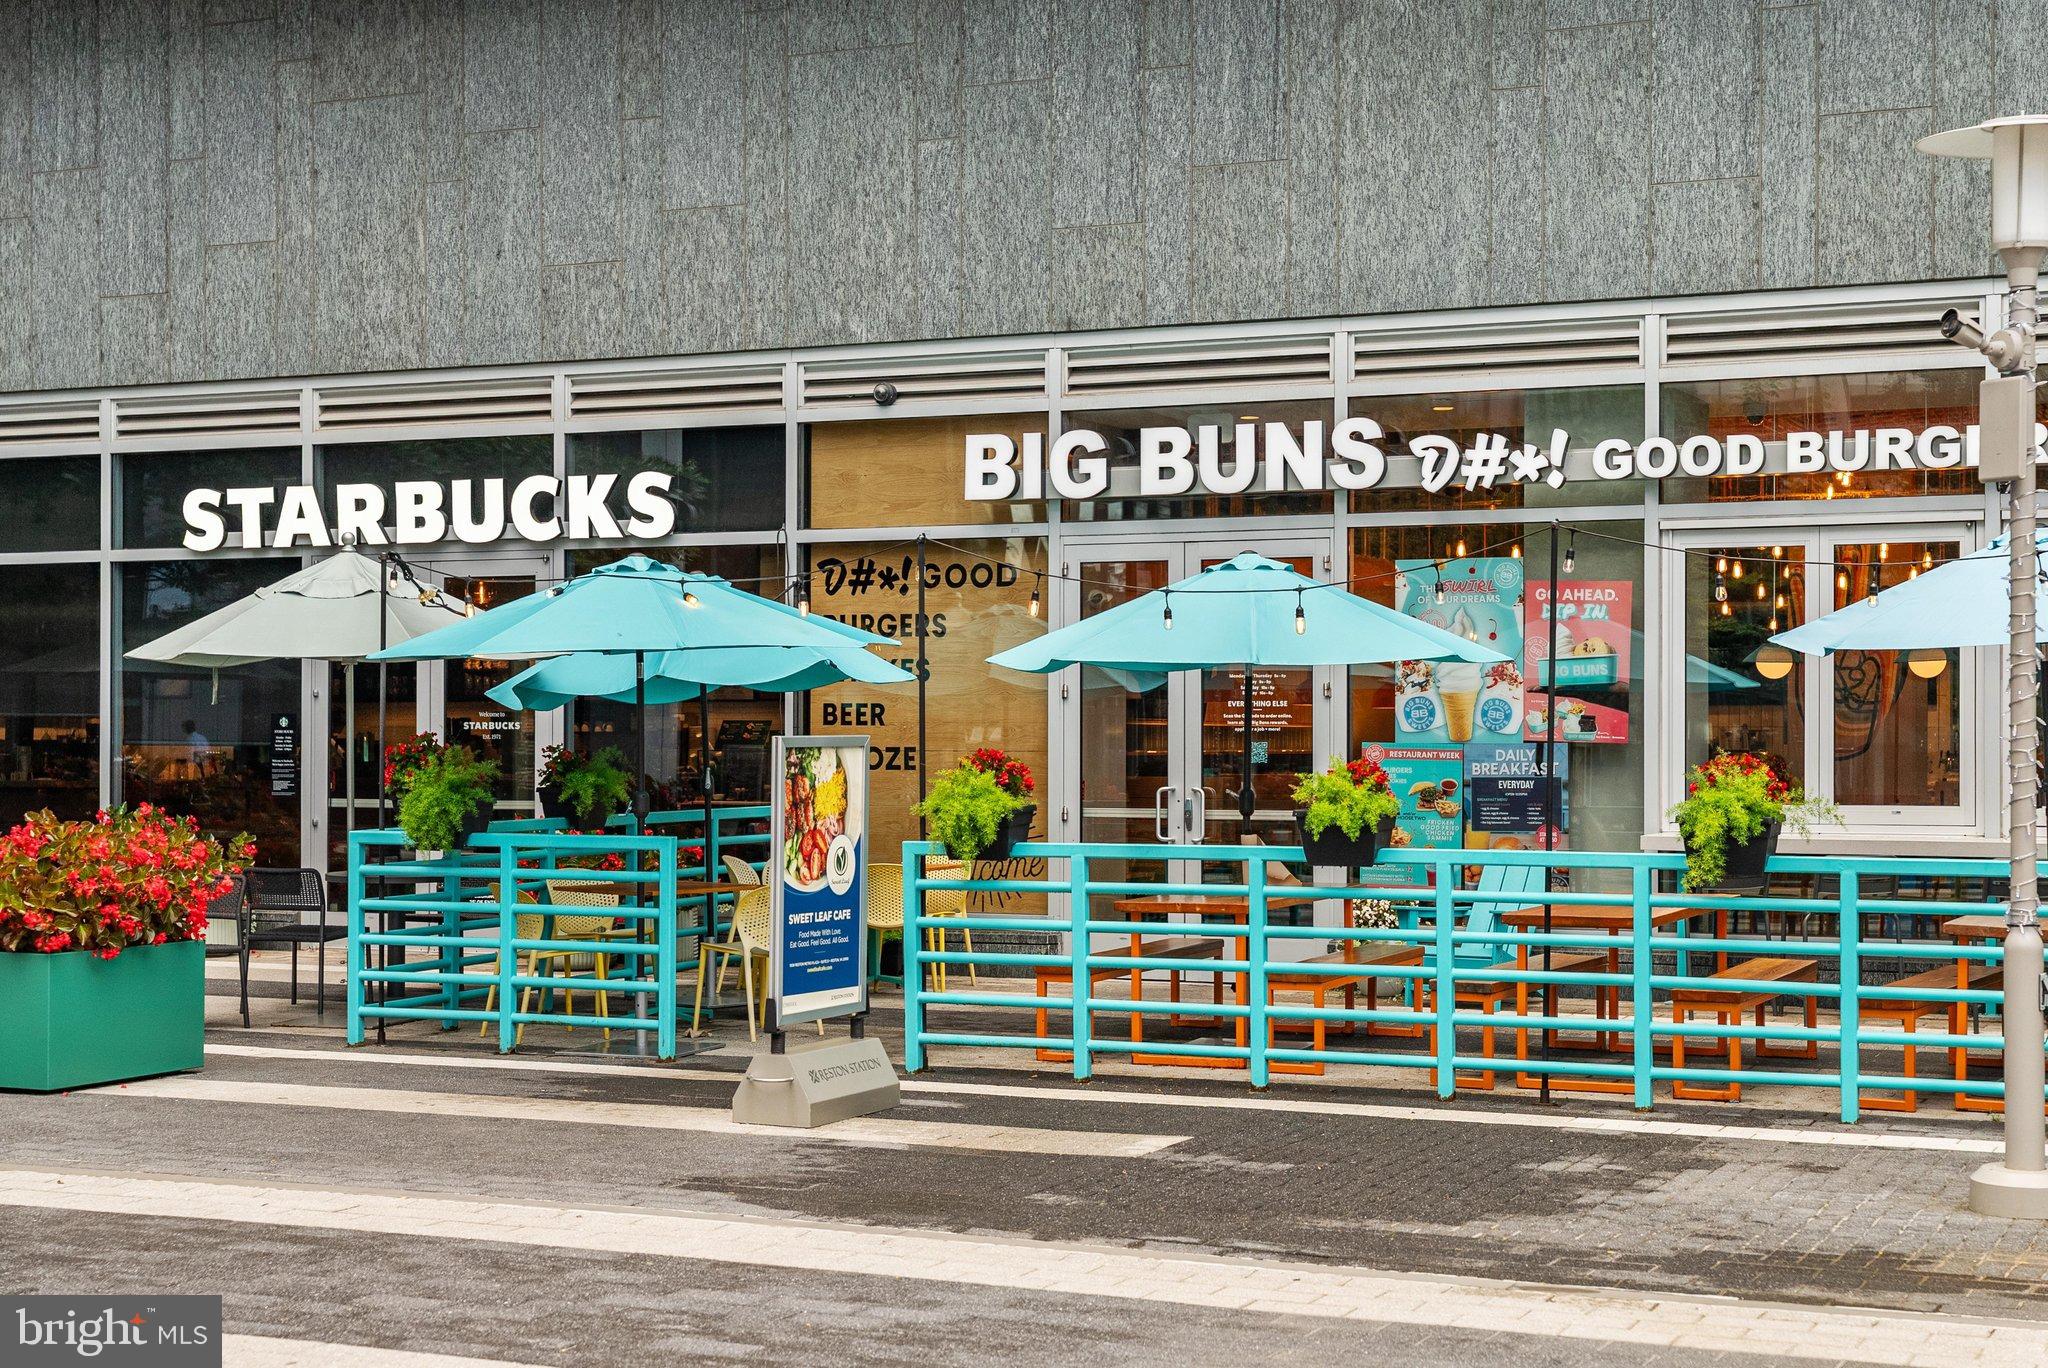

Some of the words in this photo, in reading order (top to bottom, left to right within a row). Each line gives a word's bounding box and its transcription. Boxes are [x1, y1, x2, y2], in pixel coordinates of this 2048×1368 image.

[965, 430, 1110, 500] BIG
[1140, 417, 1386, 495] BUNS
[1592, 434, 1766, 480] GOOD
[182, 471, 678, 551] STARBUCKS
[924, 562, 1018, 588] GOOD
[1420, 584, 1436, 593] TH
[1441, 579, 1498, 593] SWIRL
[1417, 596, 1431, 604] OF
[1461, 594, 1501, 604] DREAMS
[1562, 588, 1619, 601] AHEAD.
[1581, 603, 1609, 620] IN.
[1572, 663, 1609, 676] BUNS
[822, 702, 886, 727] BEER
[463, 721, 521, 730] STARBUCKS
[869, 746, 917, 771] OZE
[1389, 751, 1437, 759] RESTAURANT
[1495, 749, 1535, 761] DAILY
[1472, 762, 1559, 775] BREAKFAST
[1498, 780, 1535, 789] EVERYDAY
[788, 913, 814, 925] SWEET
[814, 910, 833, 922] LEAF
[833, 908, 851, 920] CAFE
[818, 1065, 851, 1082] RESTON
[849, 1057, 882, 1074] STATION
